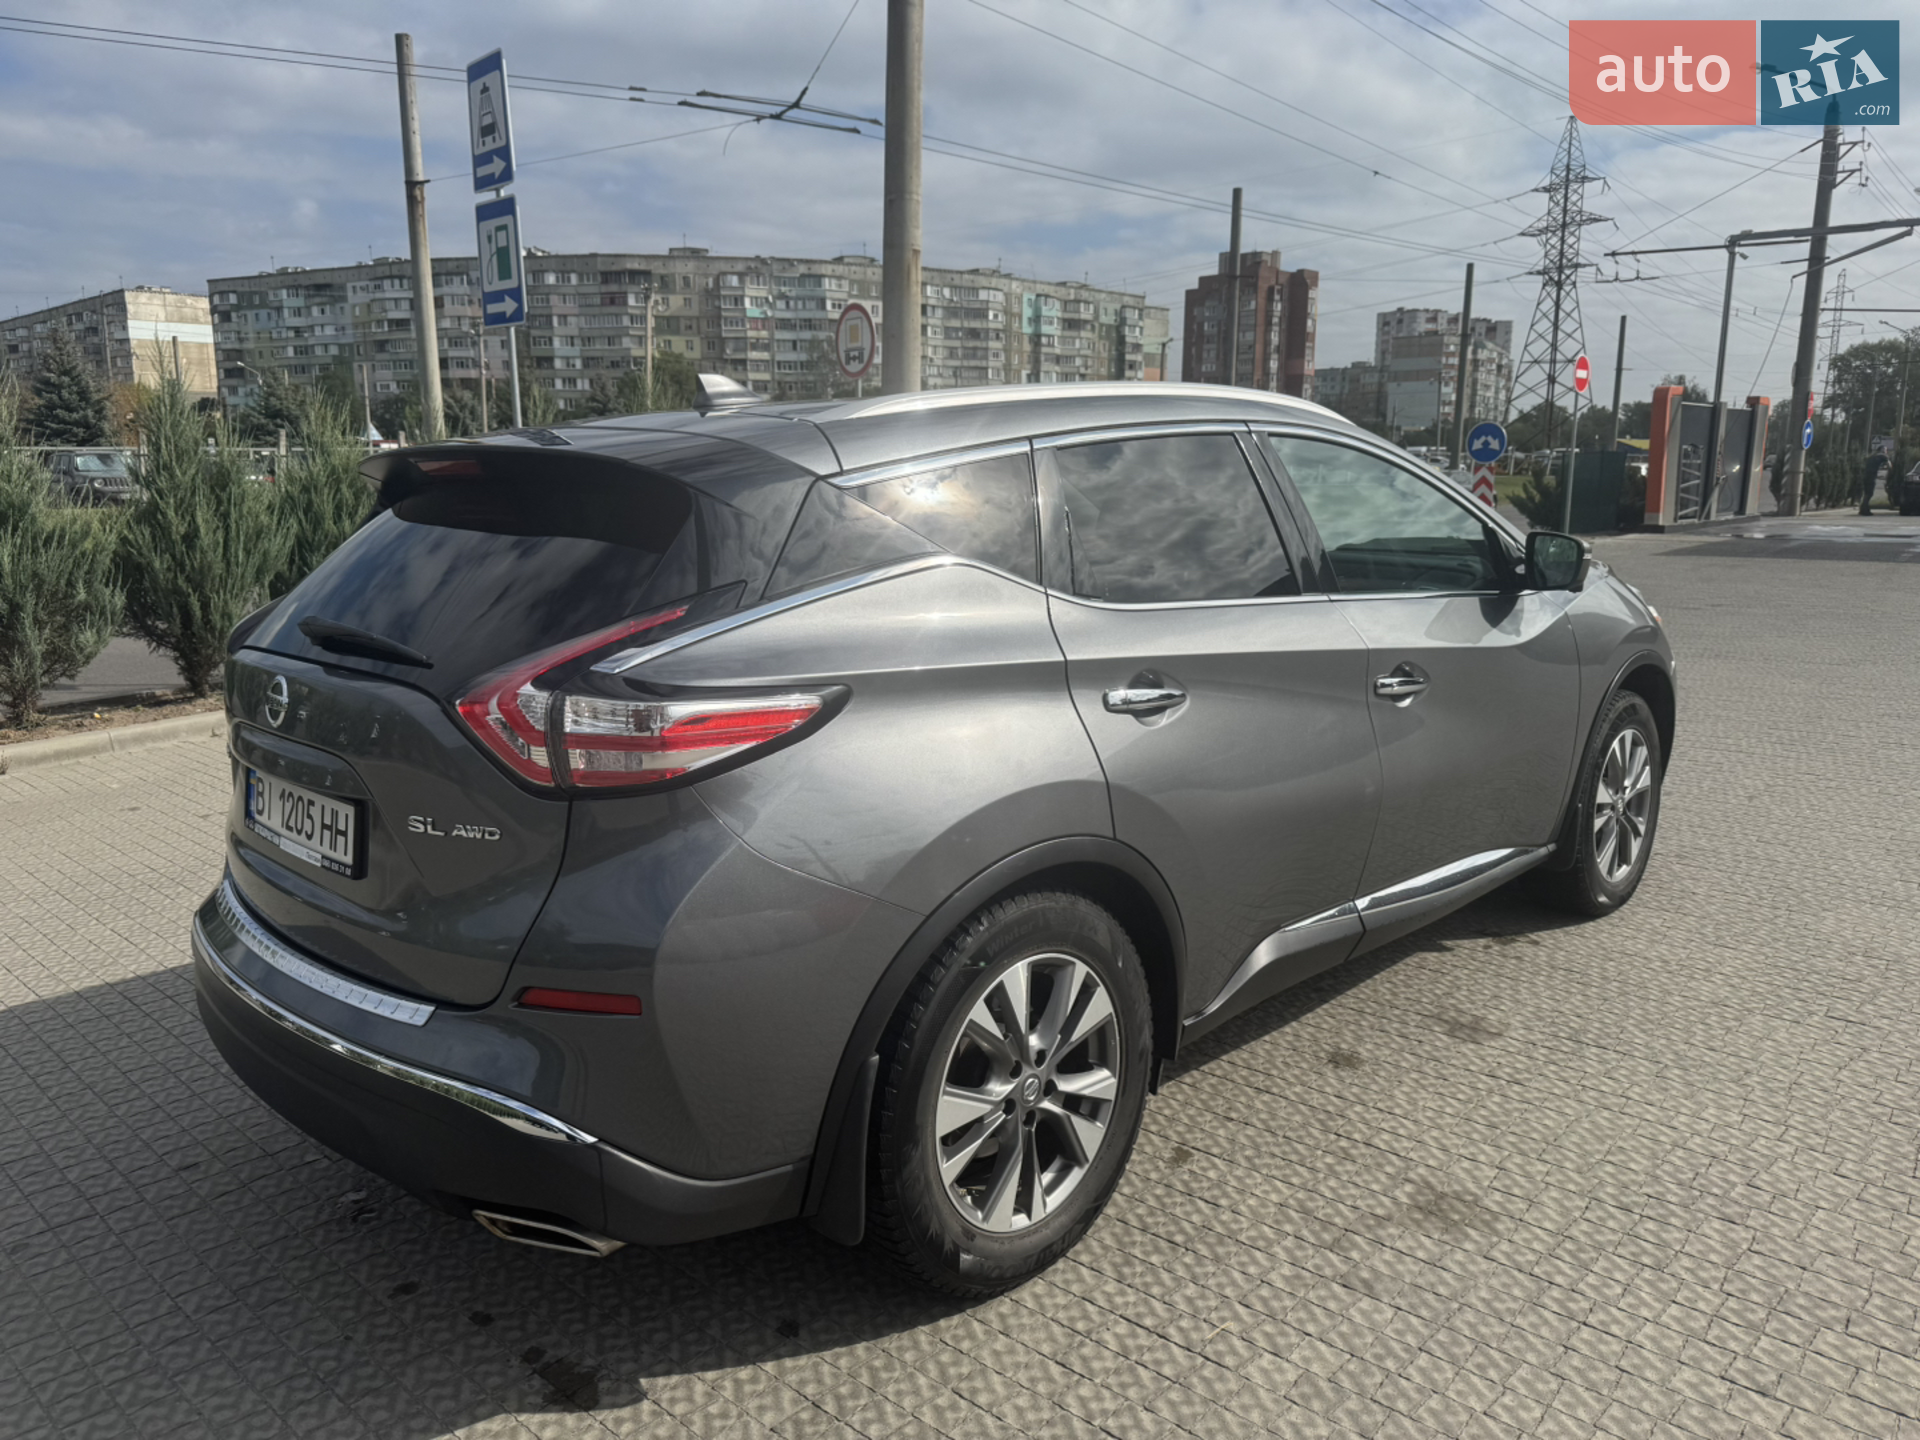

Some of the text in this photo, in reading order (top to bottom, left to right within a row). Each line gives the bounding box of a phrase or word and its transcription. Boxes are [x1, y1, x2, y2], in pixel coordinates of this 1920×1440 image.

[256, 776, 272, 821] BI
[279, 788, 315, 842] 1205
[320, 804, 349, 857] HH
[408, 815, 501, 840] SL AWD
